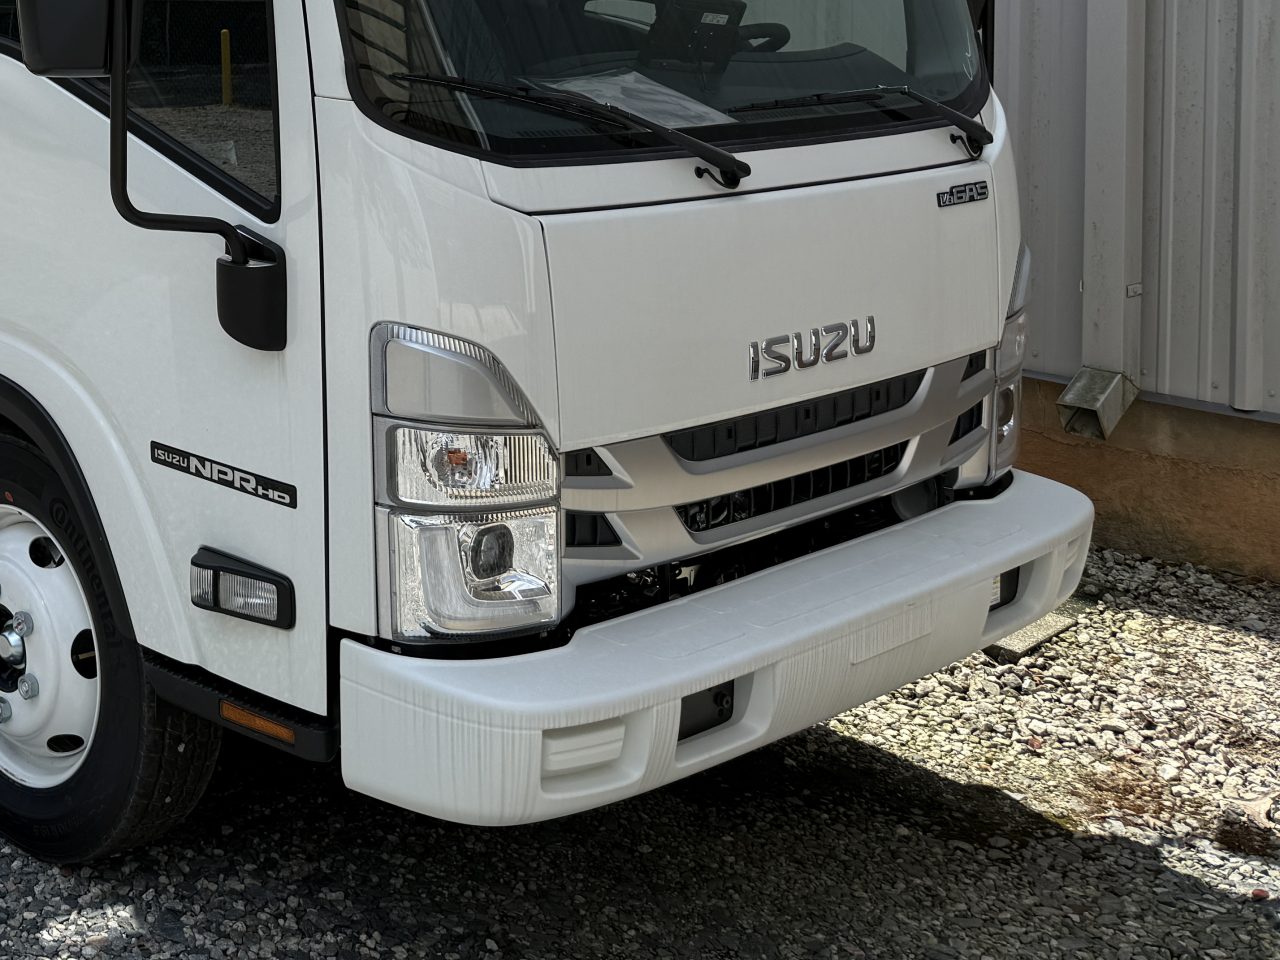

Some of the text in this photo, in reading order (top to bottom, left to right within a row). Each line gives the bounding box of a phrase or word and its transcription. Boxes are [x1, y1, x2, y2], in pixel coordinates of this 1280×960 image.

[953, 182, 988, 203] GAS
[748, 315, 876, 382] ISUZU
[154, 448, 188, 467] ISUZU
